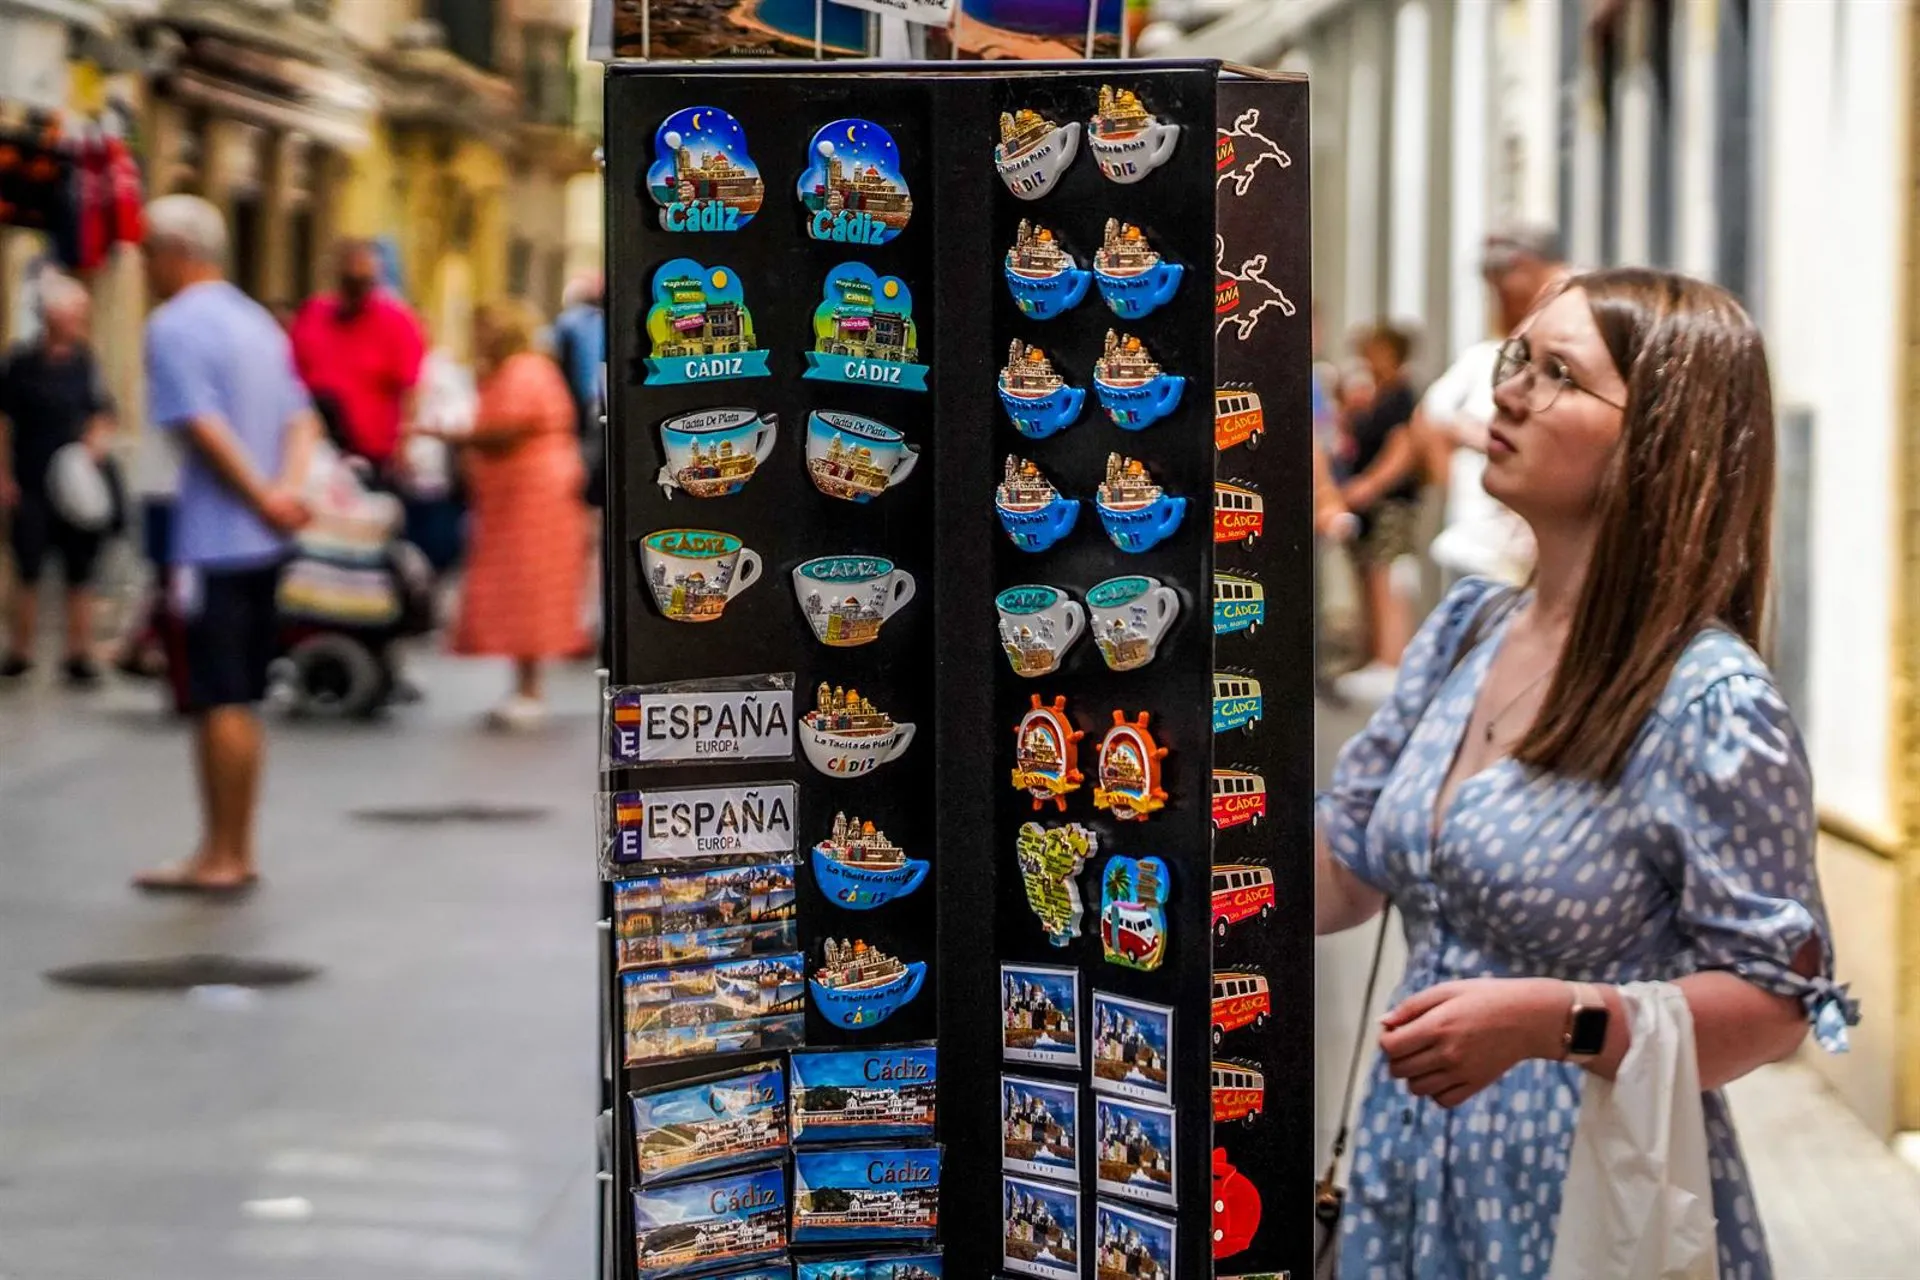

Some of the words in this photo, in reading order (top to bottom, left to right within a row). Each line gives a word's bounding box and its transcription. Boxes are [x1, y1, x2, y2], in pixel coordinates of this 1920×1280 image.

[666, 199, 741, 233] Cádiz
[812, 208, 888, 245] Cádiz
[685, 357, 742, 378] CÁDIZ
[844, 360, 902, 383] CÁDIZ
[681, 419, 704, 430] Tacita
[718, 412, 739, 423] Plata
[865, 424, 887, 437] Plata
[1224, 413, 1258, 433] CÁDIZ
[1223, 512, 1261, 528] CÁDIZ
[1224, 601, 1261, 618] CÁDIZ
[647, 694, 788, 740] ESPAÑA
[1221, 700, 1259, 716] CÁDIZ
[621, 732, 635, 756] E
[696, 740, 739, 753] EUROPA
[815, 735, 826, 744] La
[829, 739, 858, 749] Tacita
[827, 755, 875, 772] CÁDIZ
[649, 791, 790, 838] ESPAÑA
[1225, 796, 1263, 813] CÁDIZ
[622, 830, 637, 854] E
[697, 837, 741, 851] EUROPA
[1234, 887, 1272, 906] CÁDIZ
[863, 1056, 929, 1082] Cádiz
[709, 1079, 775, 1114] Ciz
[866, 1159, 932, 1185] Cádiz
[709, 1184, 776, 1215] Cádiz
